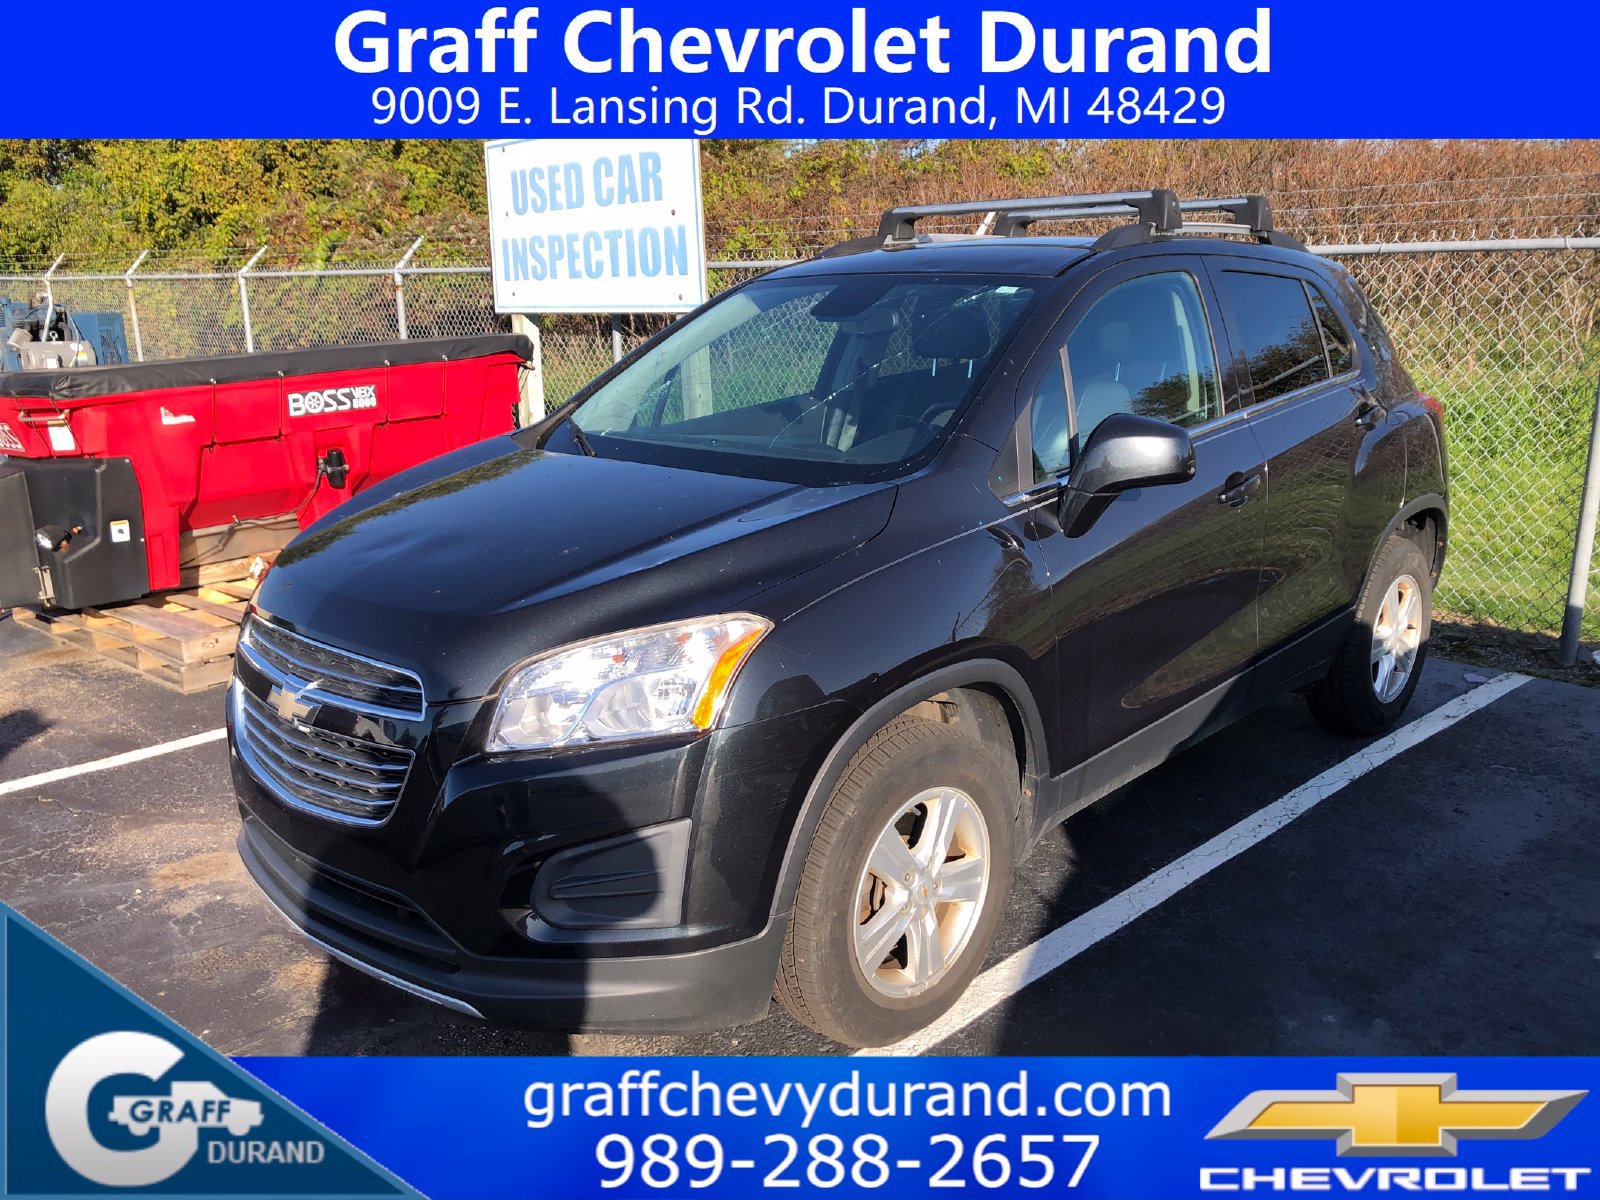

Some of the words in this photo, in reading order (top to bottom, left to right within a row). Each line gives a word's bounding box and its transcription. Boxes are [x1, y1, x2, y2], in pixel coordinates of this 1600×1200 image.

[511, 162, 584, 215] USED
[593, 152, 663, 207] CAR
[502, 225, 688, 281] INSPECTION
[288, 387, 352, 416] BOSS
[350, 384, 376, 399] VBX
